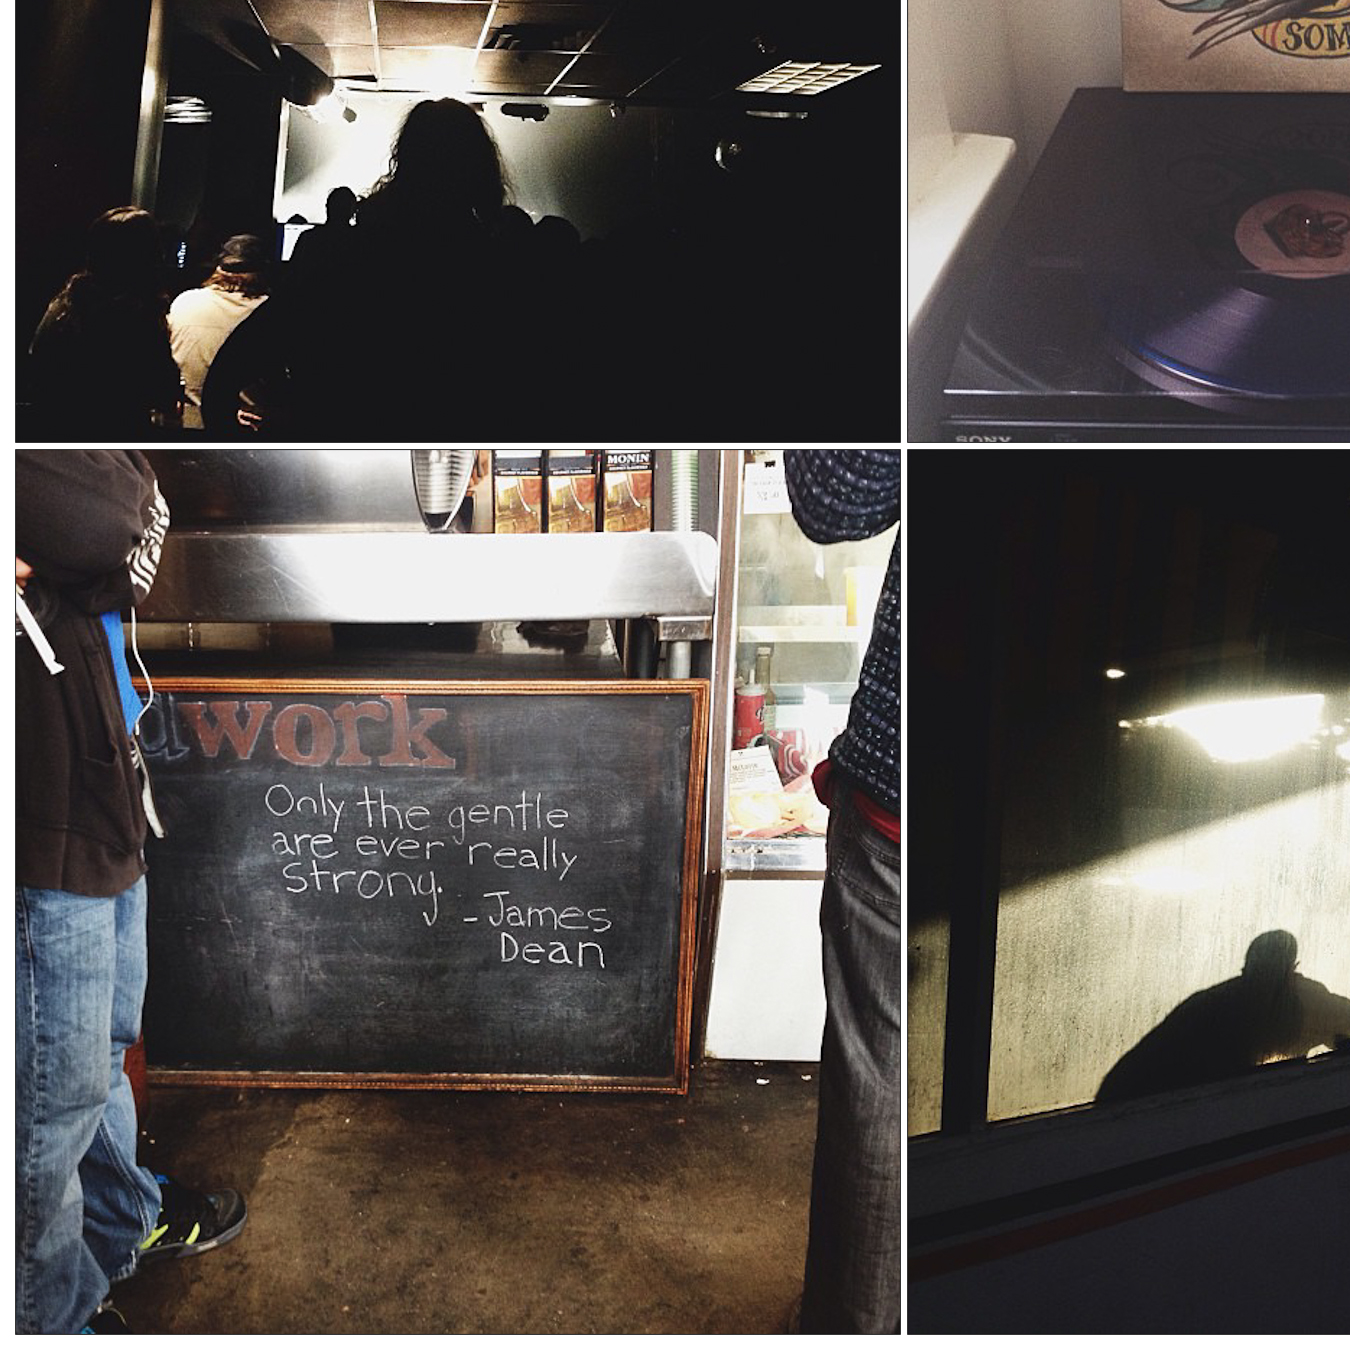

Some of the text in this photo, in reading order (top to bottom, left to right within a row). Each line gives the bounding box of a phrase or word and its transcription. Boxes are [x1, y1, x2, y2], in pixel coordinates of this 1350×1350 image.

[607, 453, 650, 464] MONIN
[265, 783, 569, 844] Only the gentle
[272, 832, 578, 881] are ever really
[500, 932, 606, 969] Dean
